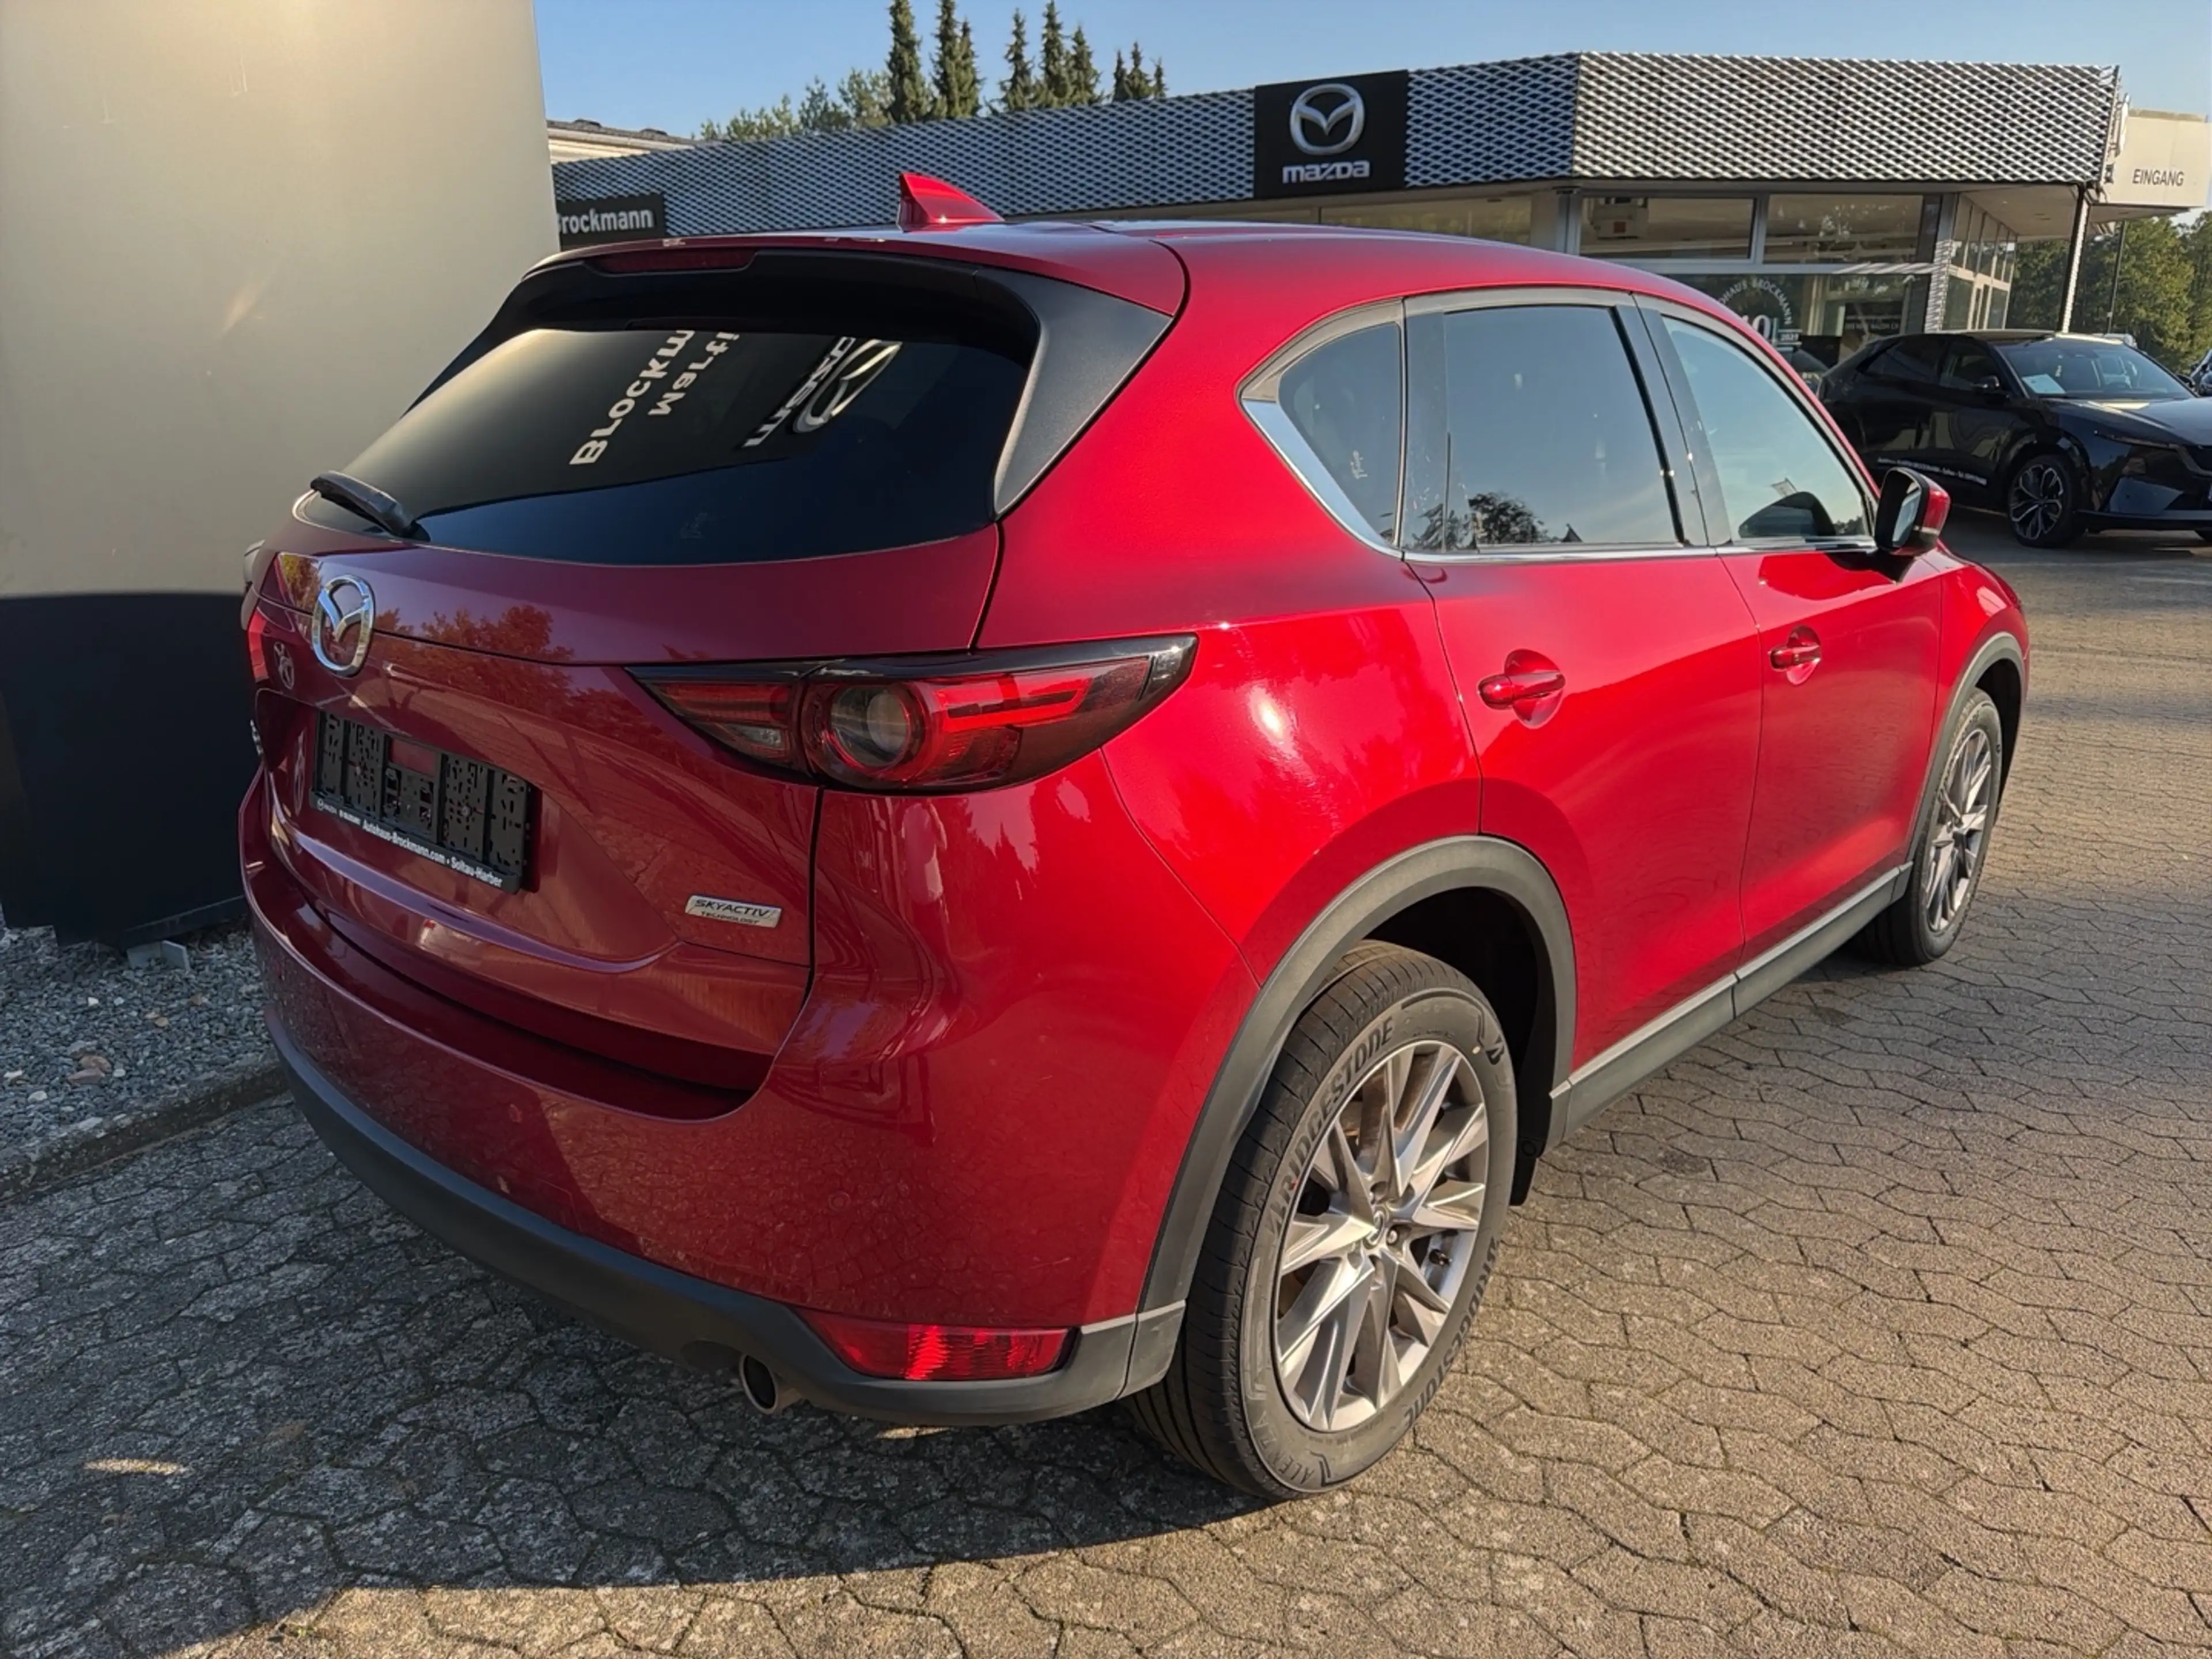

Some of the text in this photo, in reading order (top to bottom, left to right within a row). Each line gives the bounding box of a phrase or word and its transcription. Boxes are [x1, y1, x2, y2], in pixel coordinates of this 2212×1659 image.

[1282, 160, 1370, 184] mazda
[2132, 168, 2184, 187] EINGANG
[695, 899, 770, 916] SKYACTIV
[701, 911, 760, 924] TECHNOLOGY
[1267, 1016, 1393, 1235] BRIDGESTONE
